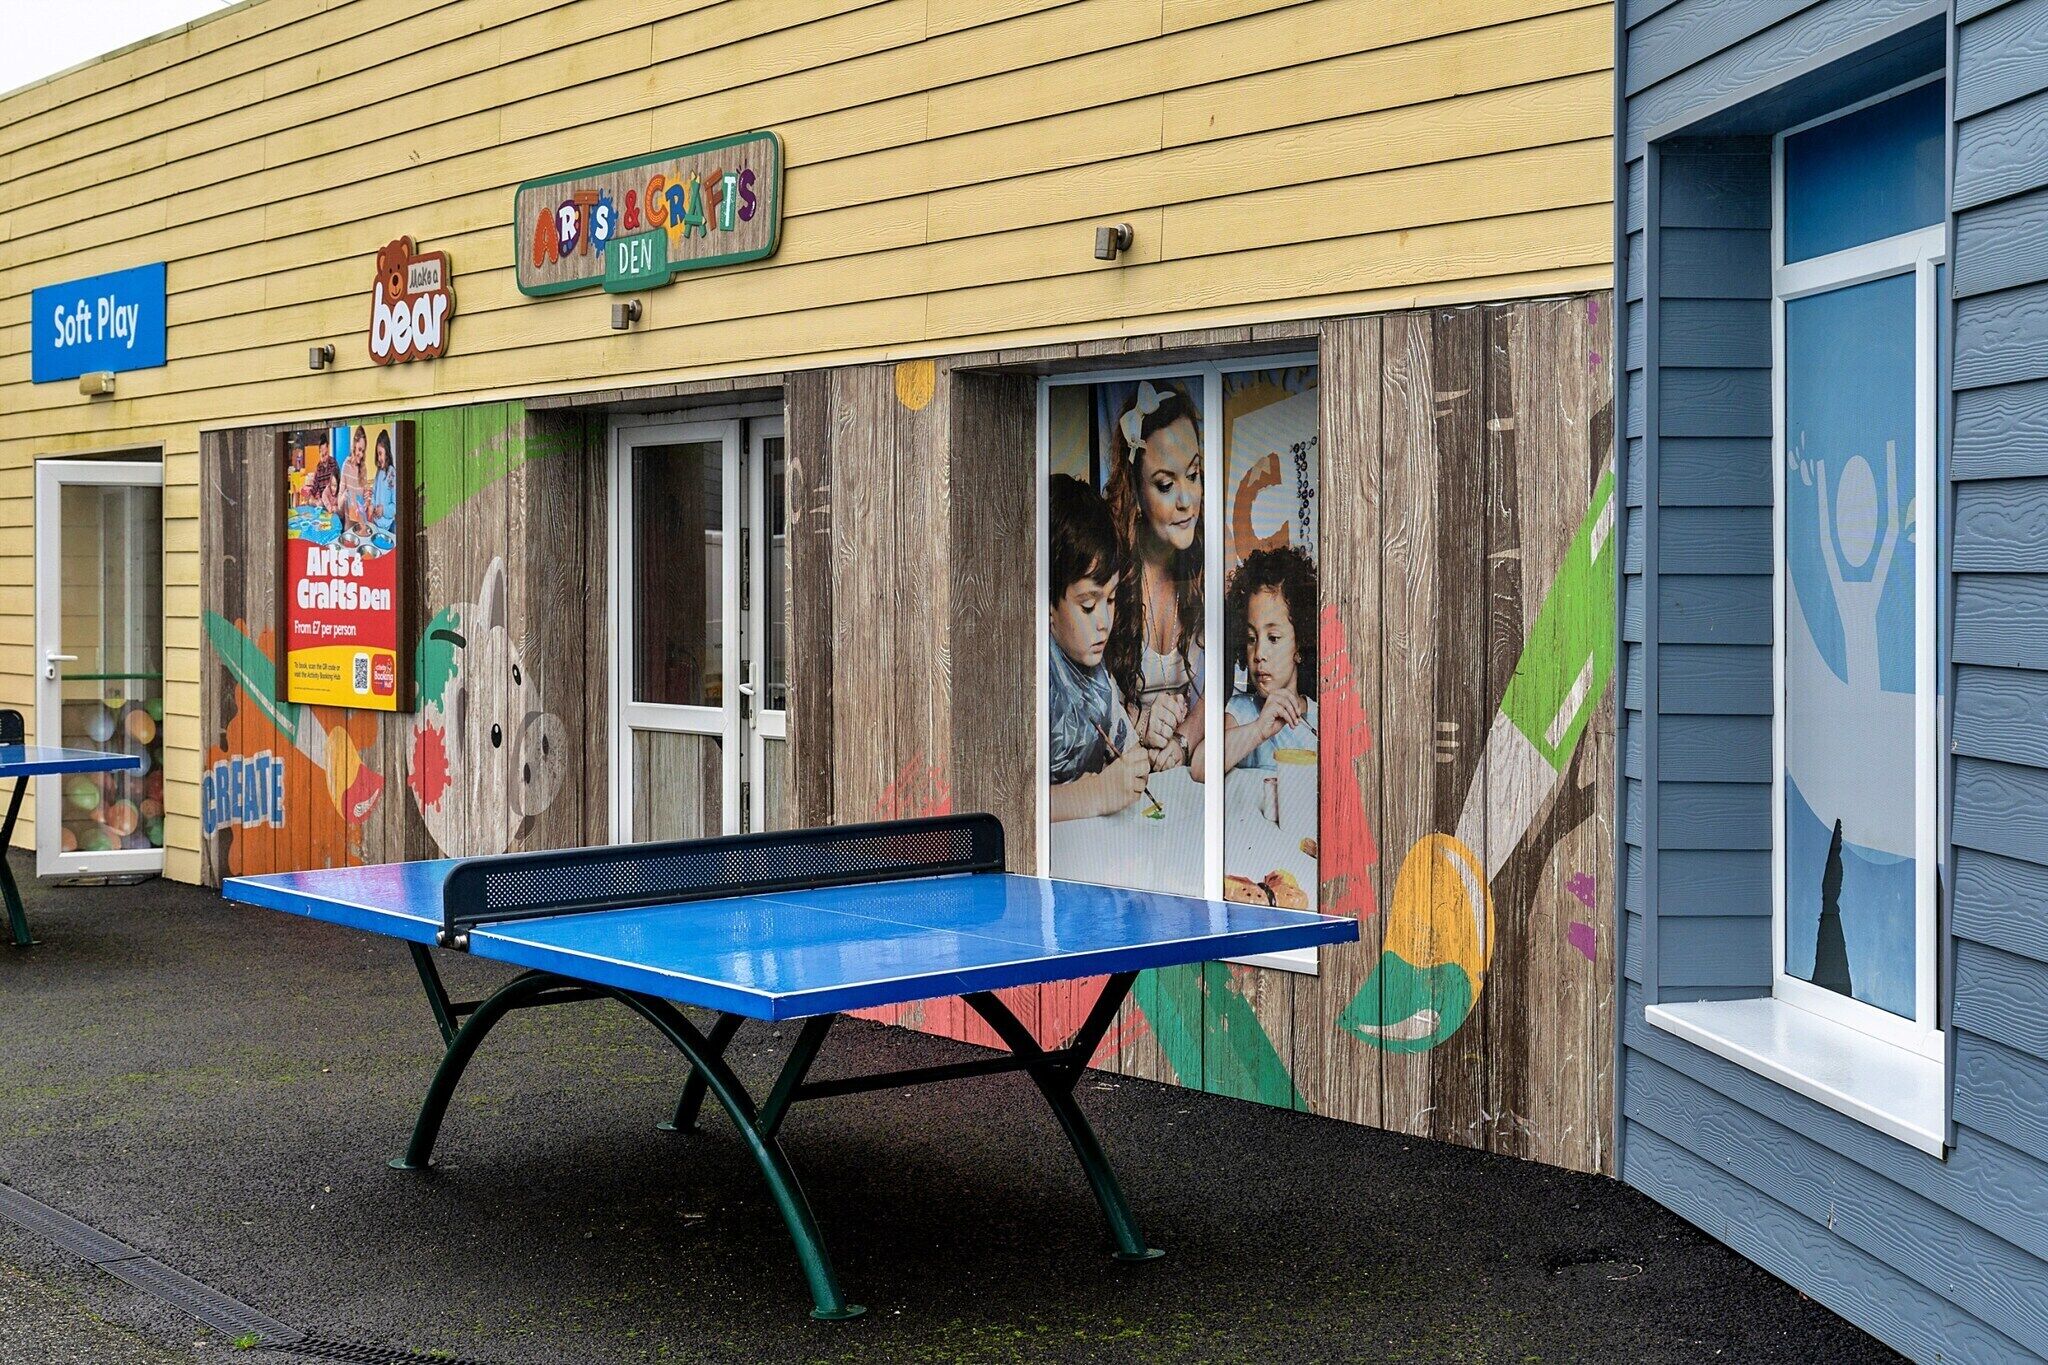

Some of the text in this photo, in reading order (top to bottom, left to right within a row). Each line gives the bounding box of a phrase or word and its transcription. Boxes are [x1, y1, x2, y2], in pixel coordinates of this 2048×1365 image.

[532, 166, 756, 268] ARTS & CRAFTS
[619, 238, 652, 274] DEN
[54, 294, 139, 349] Soft Play
[371, 282, 447, 357] bear
[306, 546, 350, 577] Arts
[297, 578, 391, 611] Crafts Den
[294, 619, 357, 638] From £7 per person
[374, 671, 393, 683] Booking
[203, 750, 285, 839] CREATE
